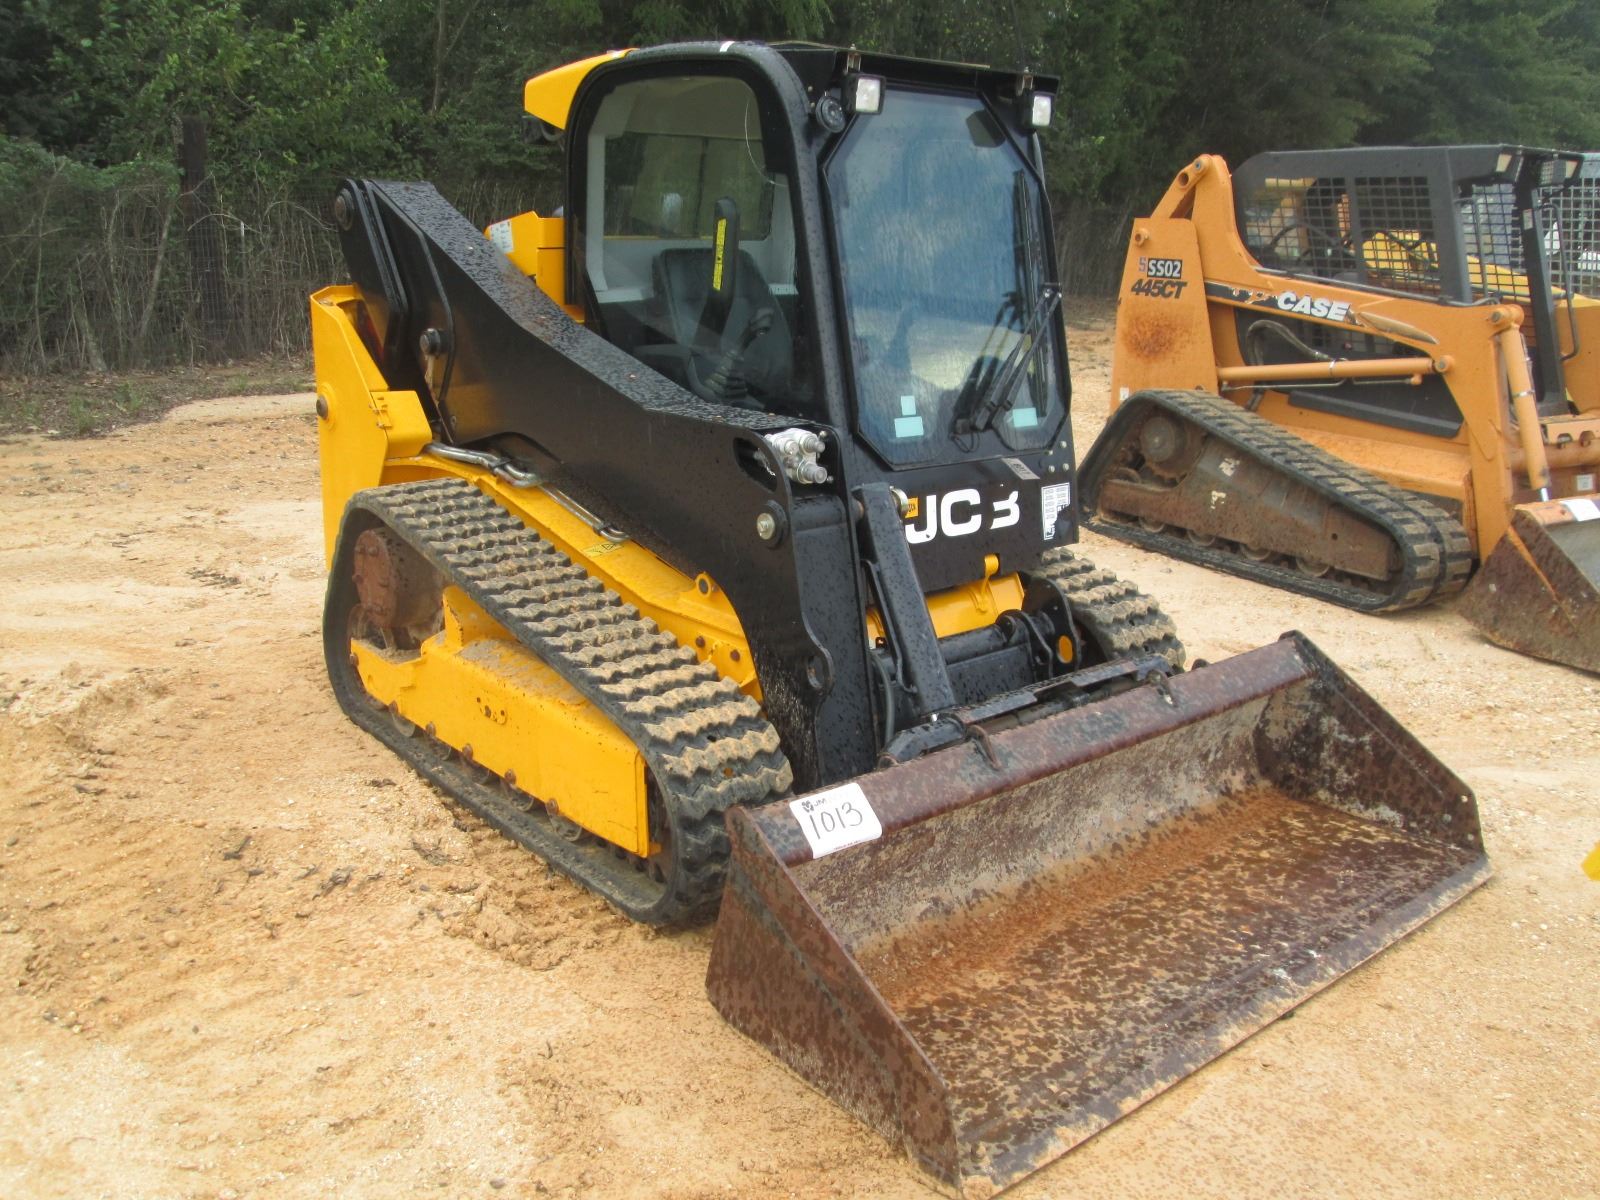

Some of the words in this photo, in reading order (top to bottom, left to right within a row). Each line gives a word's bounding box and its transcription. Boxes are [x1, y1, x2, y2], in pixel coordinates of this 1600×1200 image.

[1147, 259, 1182, 278] SS02
[1131, 279, 1188, 299] 445CT
[1277, 290, 1351, 322] CASE
[809, 801, 863, 840] 1013
